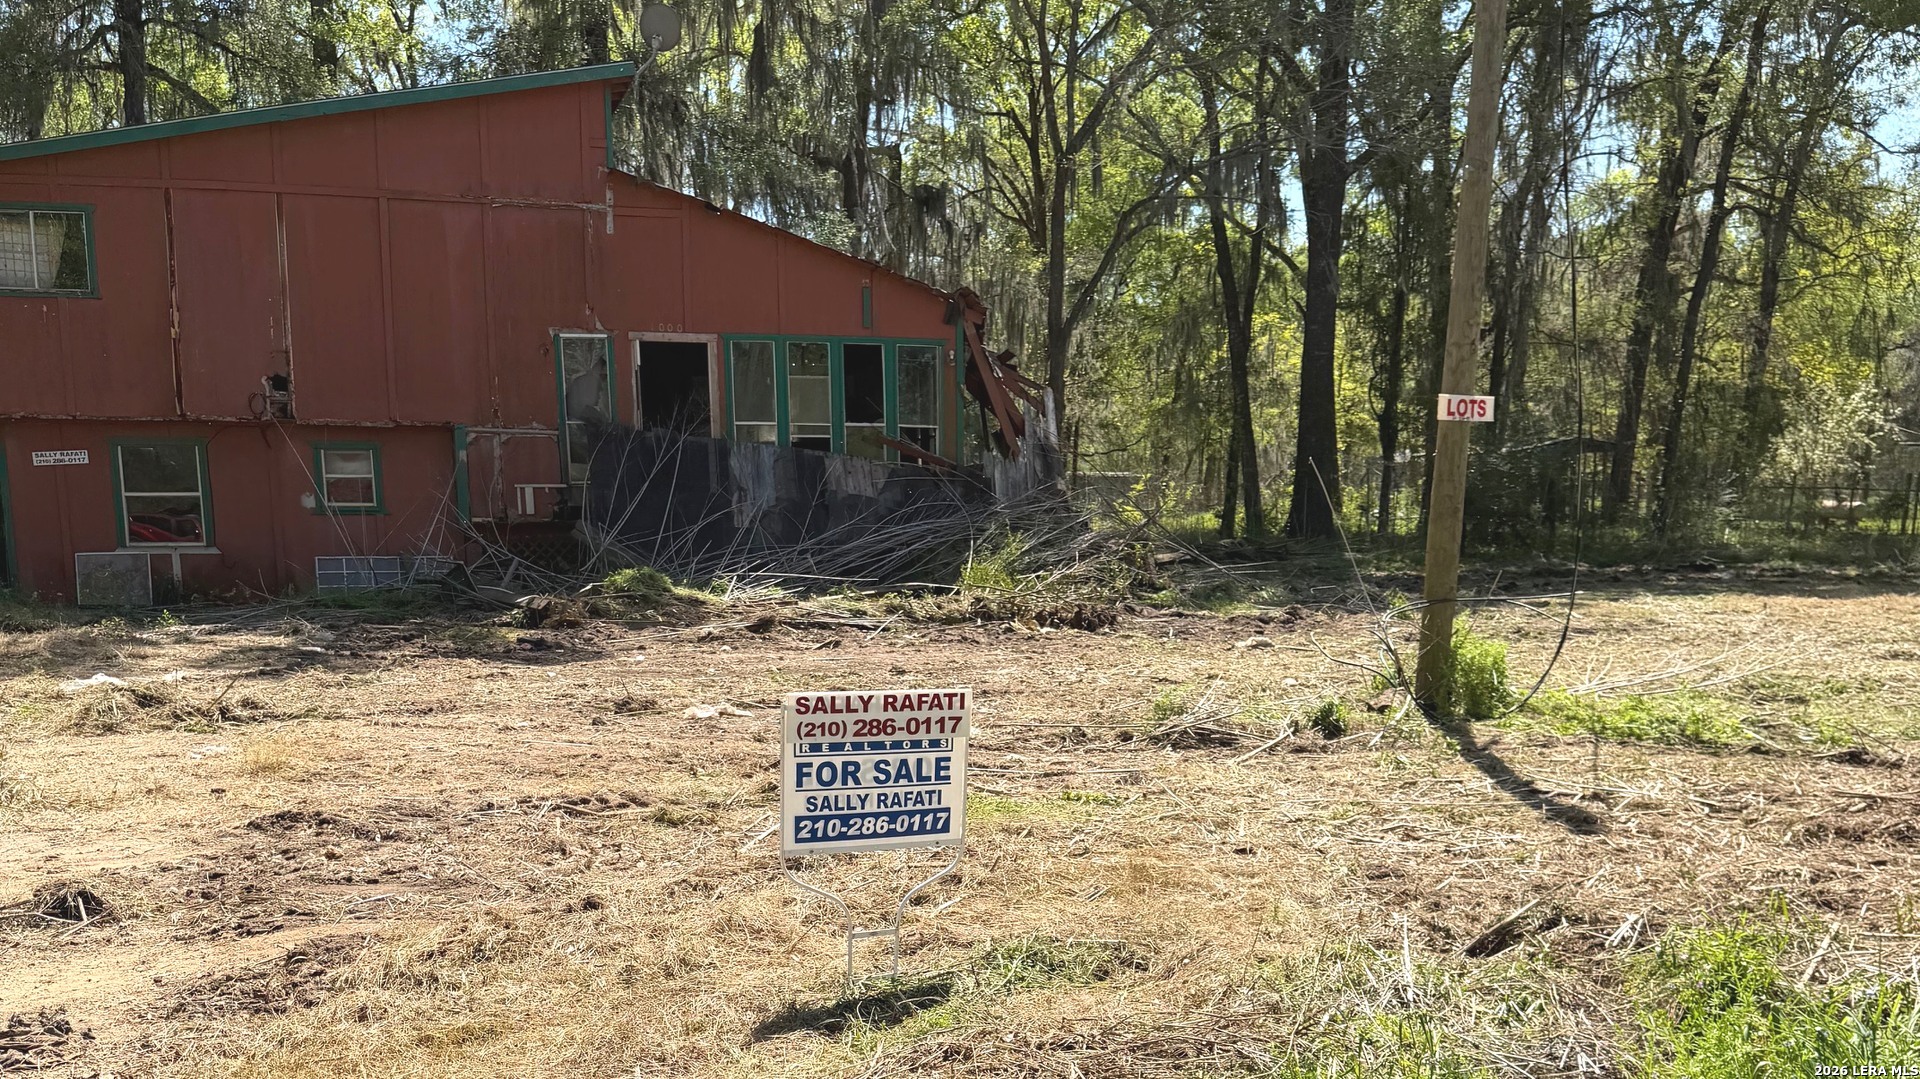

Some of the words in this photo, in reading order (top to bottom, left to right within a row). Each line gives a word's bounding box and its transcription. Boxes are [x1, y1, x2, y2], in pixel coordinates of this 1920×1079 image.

[1447, 399, 1487, 418] LOTS
[795, 695, 875, 715] SALLY
[883, 693, 965, 712] RAFATI
[796, 720, 848, 740] (210)
[852, 716, 963, 737] 286-0117
[801, 739, 948, 753] REALTORS
[796, 761, 862, 788] FOR
[873, 757, 952, 785] SALE
[806, 794, 870, 813] SALLY
[876, 790, 942, 809] RAFATI
[797, 812, 949, 839] 210-286-0117
